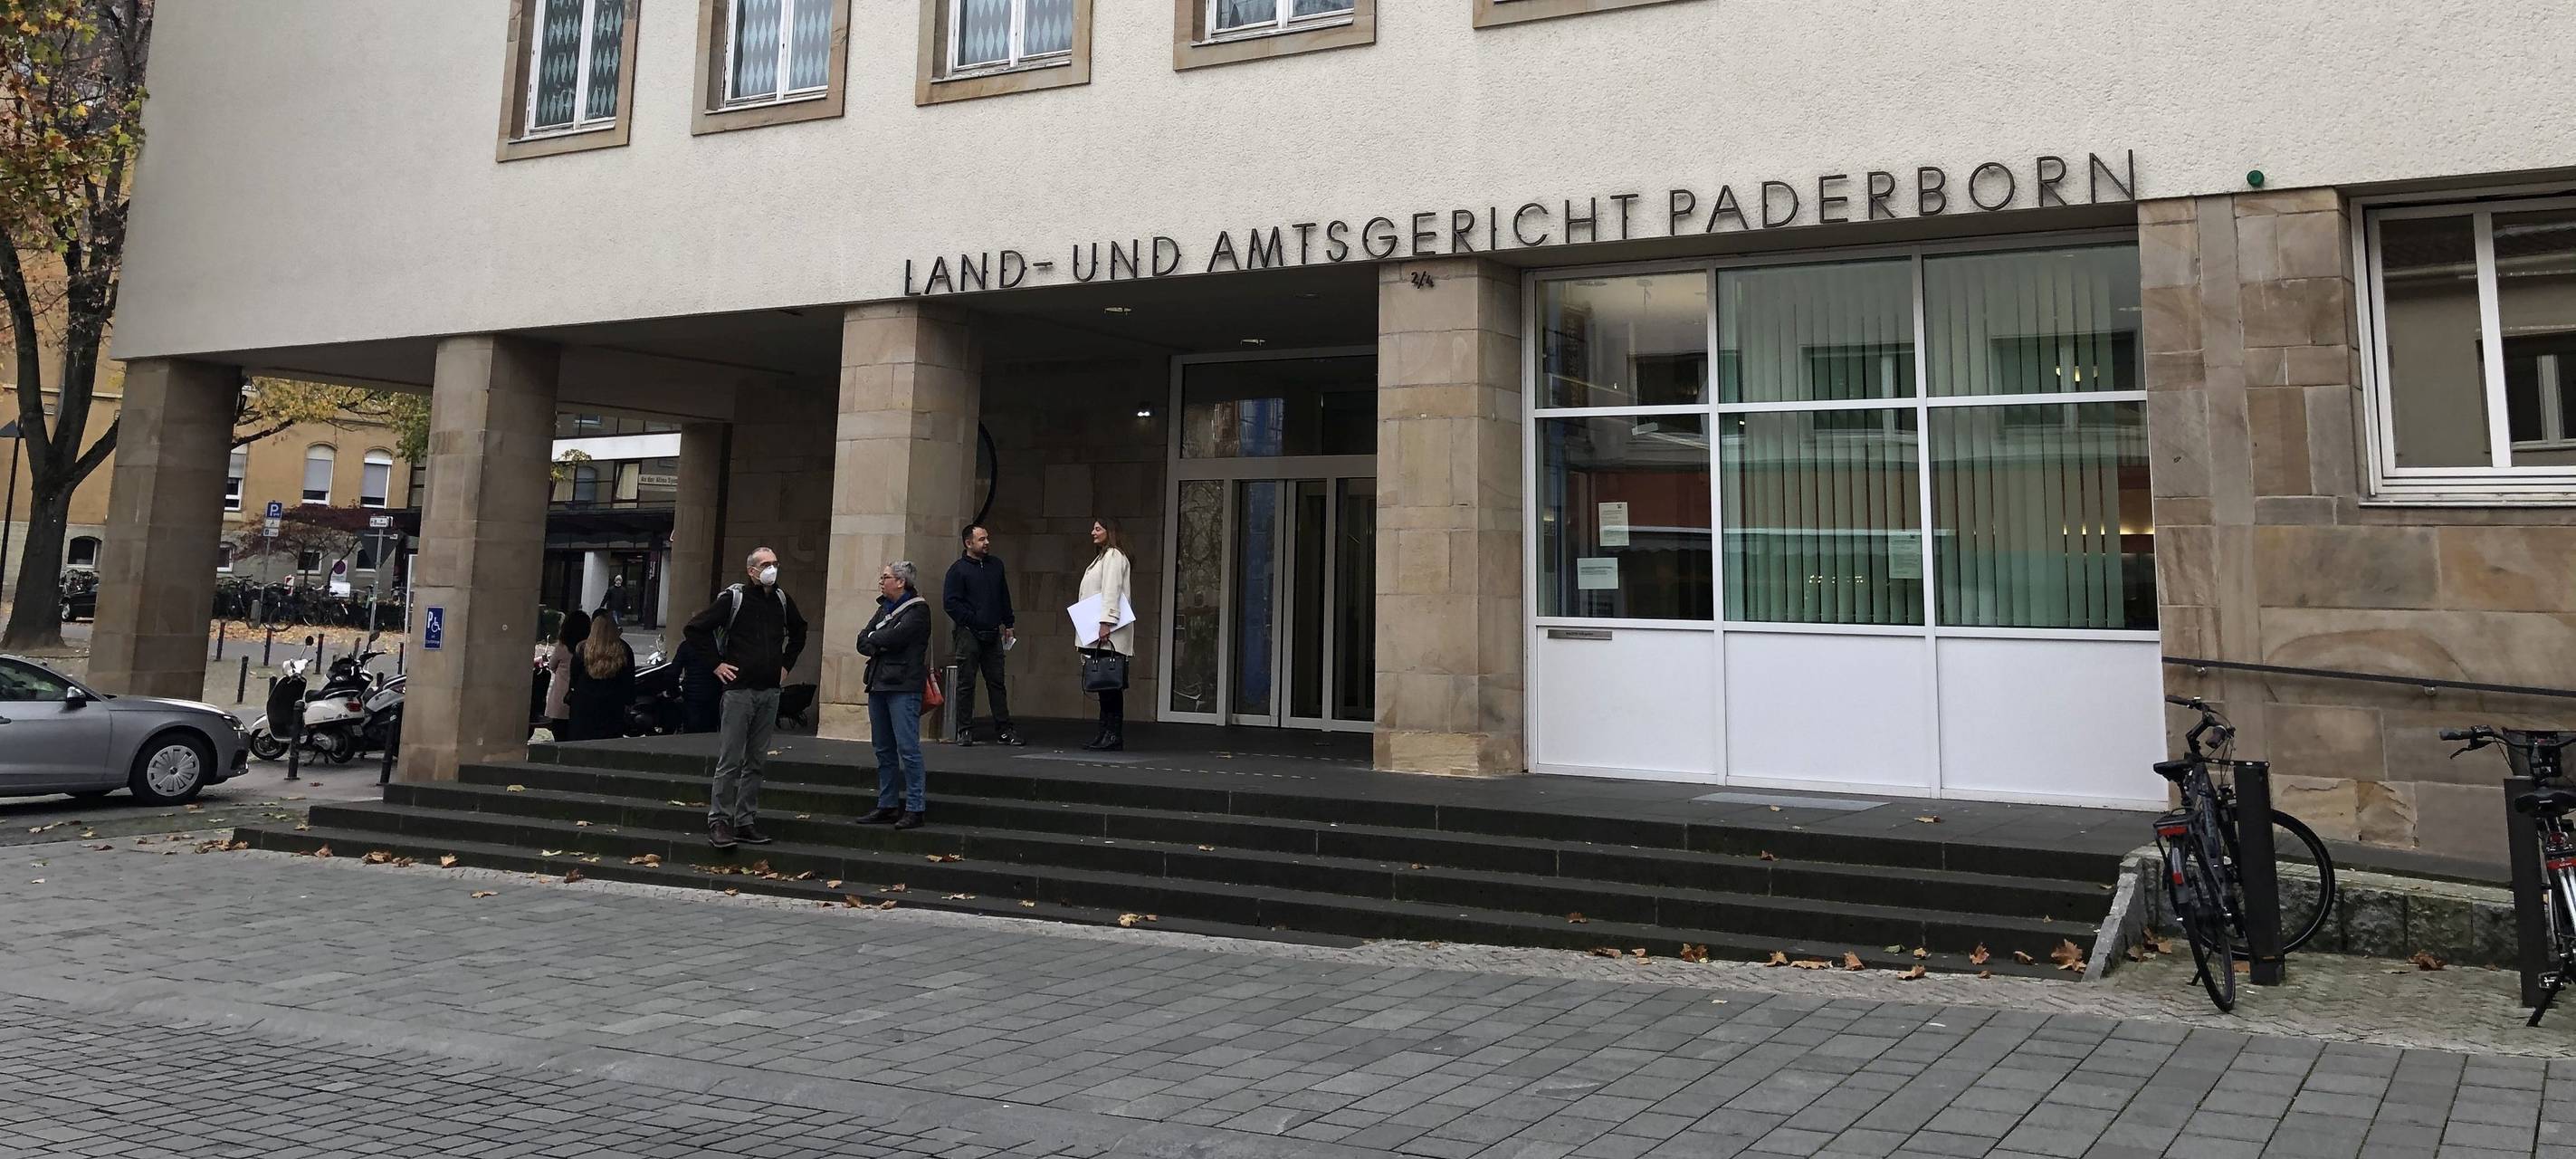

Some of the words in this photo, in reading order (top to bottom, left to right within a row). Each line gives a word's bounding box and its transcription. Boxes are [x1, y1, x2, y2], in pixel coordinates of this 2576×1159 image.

[903, 249, 1055, 297] LAND-
[1071, 234, 1182, 284] UND
[1206, 190, 1639, 274] AMTSGERICHT
[1668, 148, 2136, 235] PADERBORN
[1411, 271, 1435, 289] 2/4
